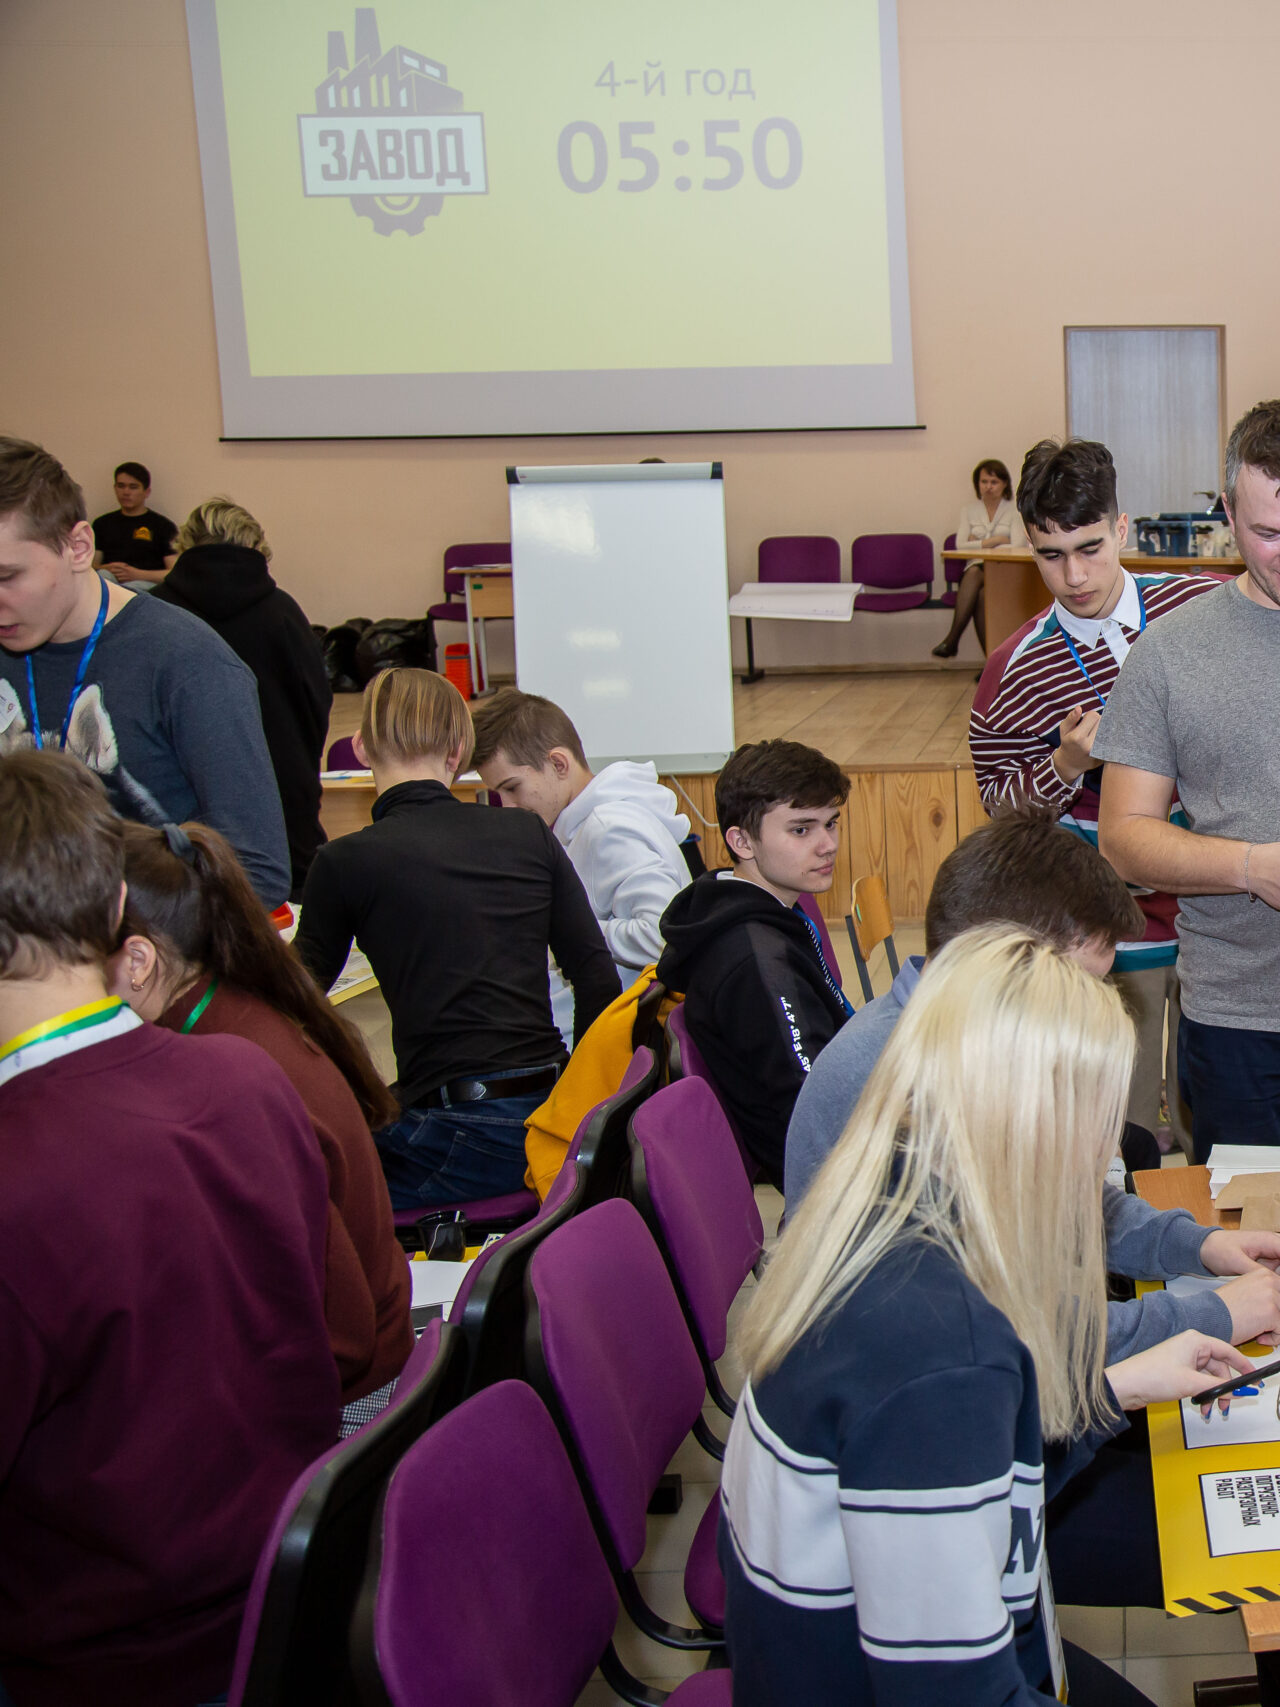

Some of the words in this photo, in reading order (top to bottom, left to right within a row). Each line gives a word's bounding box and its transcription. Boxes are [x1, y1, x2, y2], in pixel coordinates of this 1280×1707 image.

[594, 60, 667, 97] 4-й
[684, 68, 756, 101] год
[318, 128, 471, 187] ЗАВОД
[556, 116, 804, 194] 05:50
[1215, 1478, 1235, 1499] РАБОТ
[1235, 1476, 1261, 1527] РАЗГРУЗОЧНЫХ
[1254, 1475, 1279, 1517] ПОГРУЗОЧНО-
